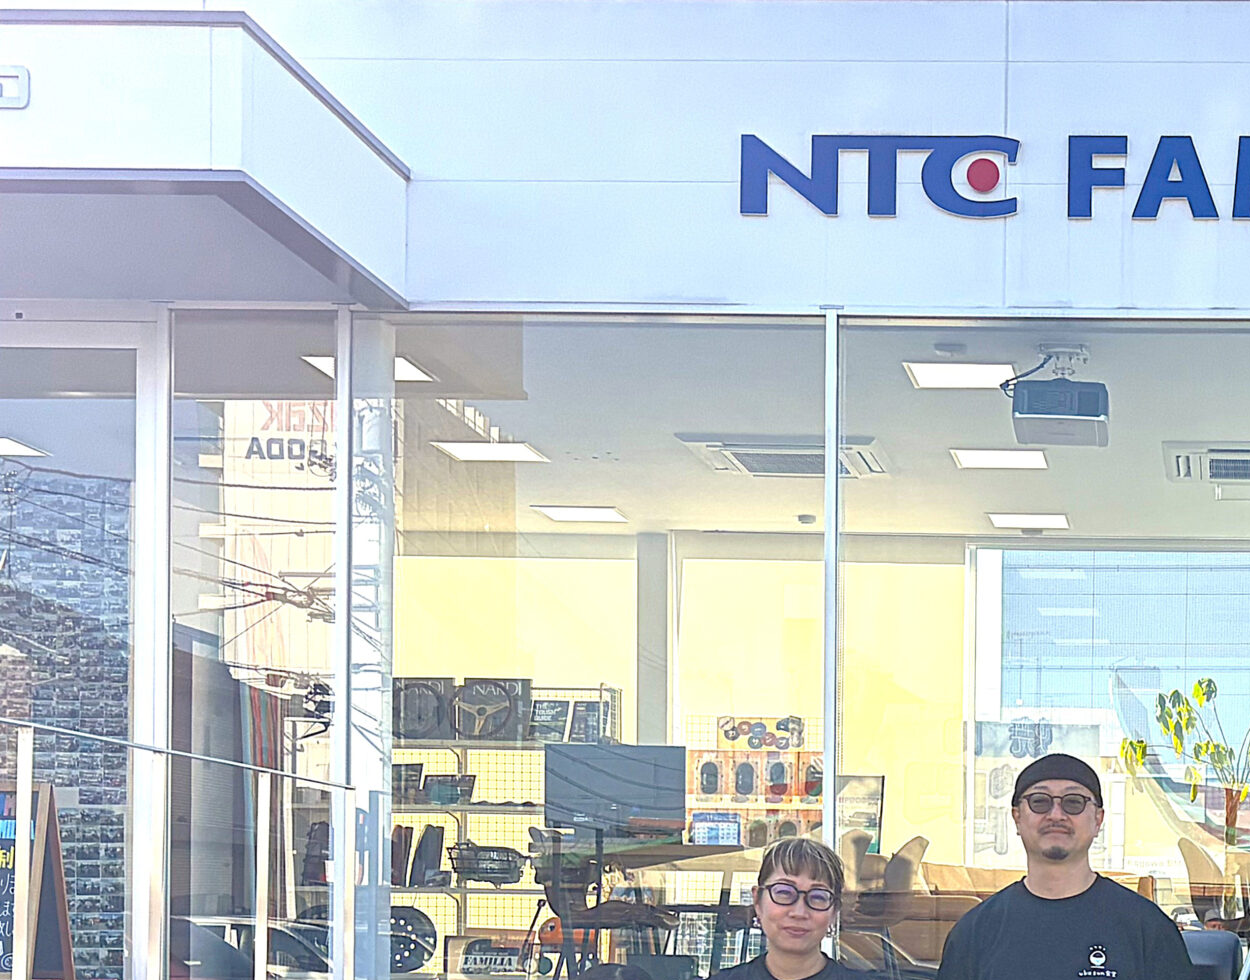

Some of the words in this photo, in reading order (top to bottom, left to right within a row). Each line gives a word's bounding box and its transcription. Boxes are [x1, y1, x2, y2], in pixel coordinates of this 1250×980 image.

[740, 134, 1021, 218] NTC
[472, 680, 522, 696] NARDI
[463, 956, 513, 966] FAMILIA
